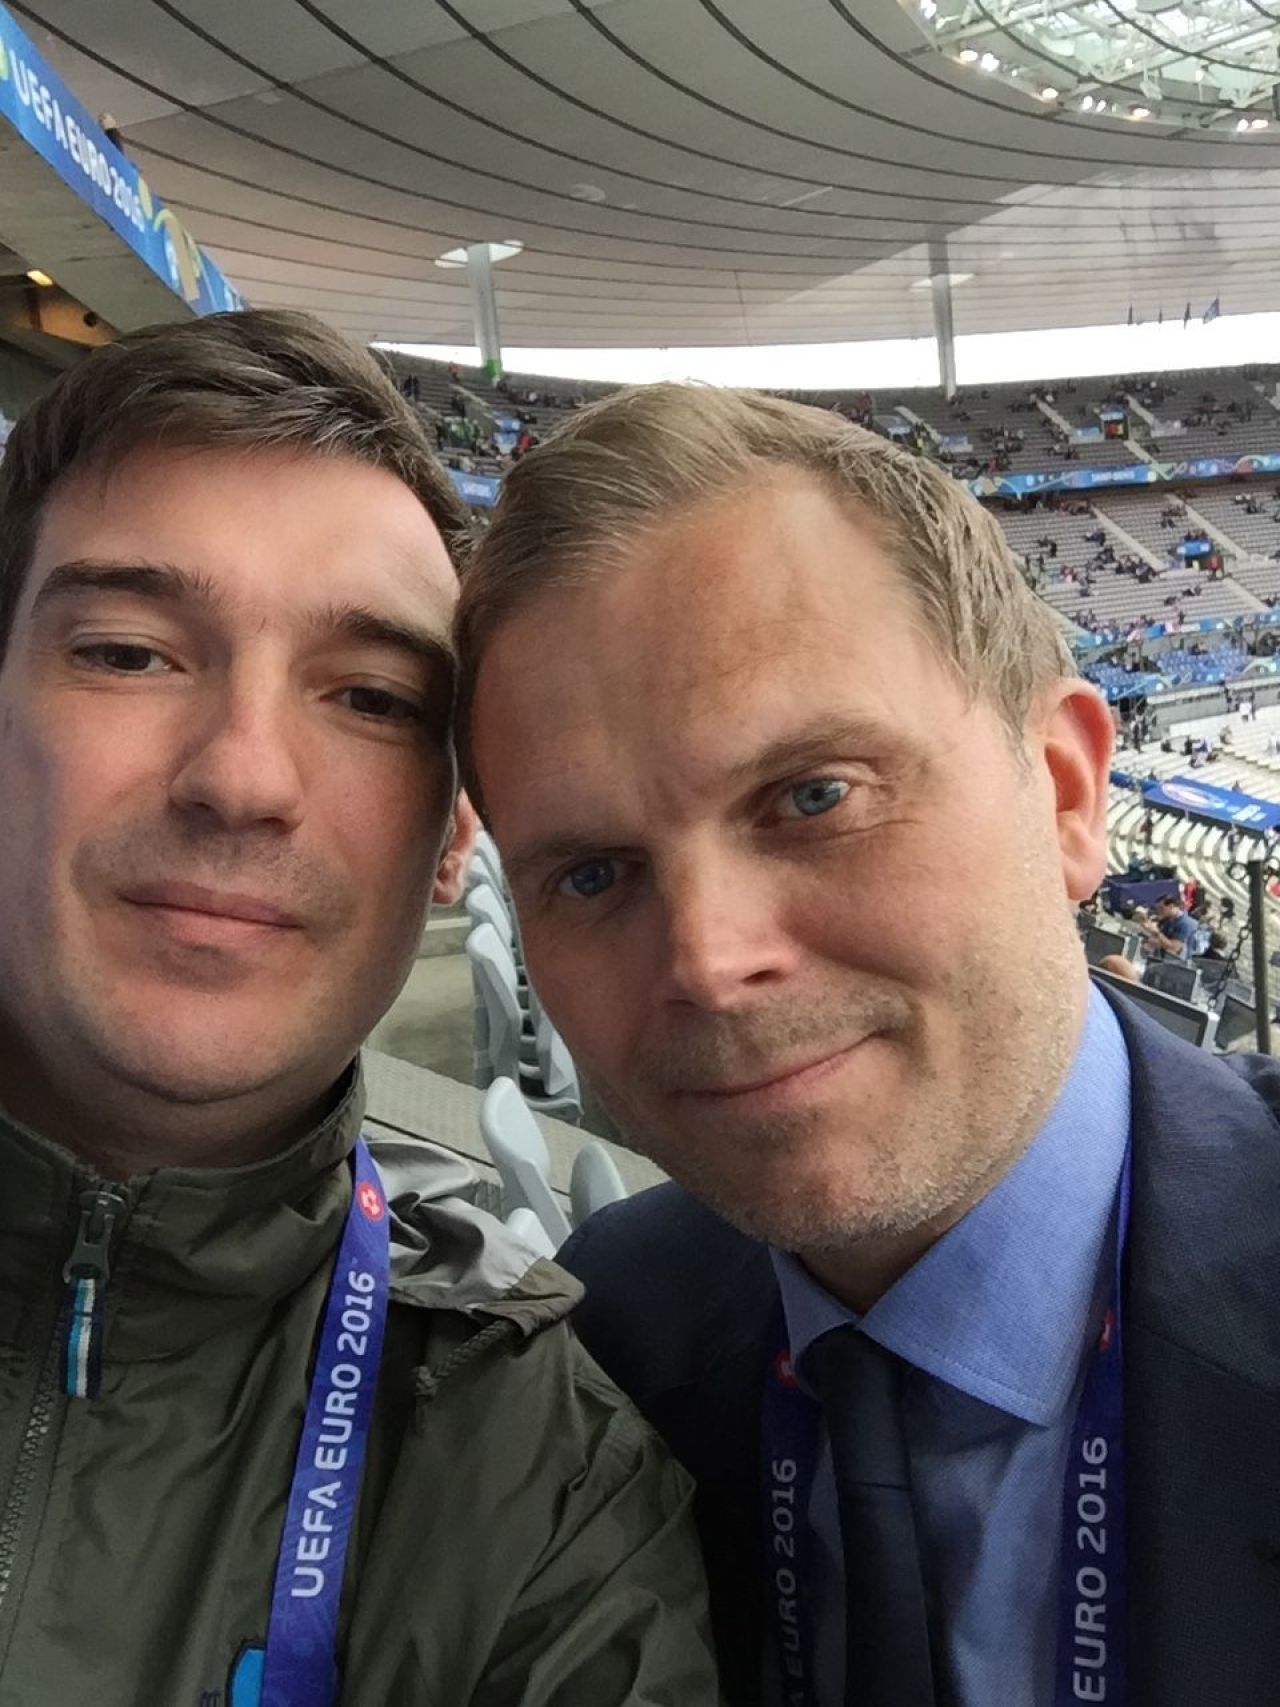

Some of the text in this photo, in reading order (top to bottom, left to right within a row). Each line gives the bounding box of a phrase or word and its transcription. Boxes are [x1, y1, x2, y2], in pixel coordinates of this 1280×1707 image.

[10, 49, 69, 149] UEFA
[291, 1271, 375, 1599] UEFA EURO 2016
[772, 1459, 797, 1558] 2016
[776, 1567, 803, 1678] EURO
[1074, 1437, 1108, 1702] EURO 2016
